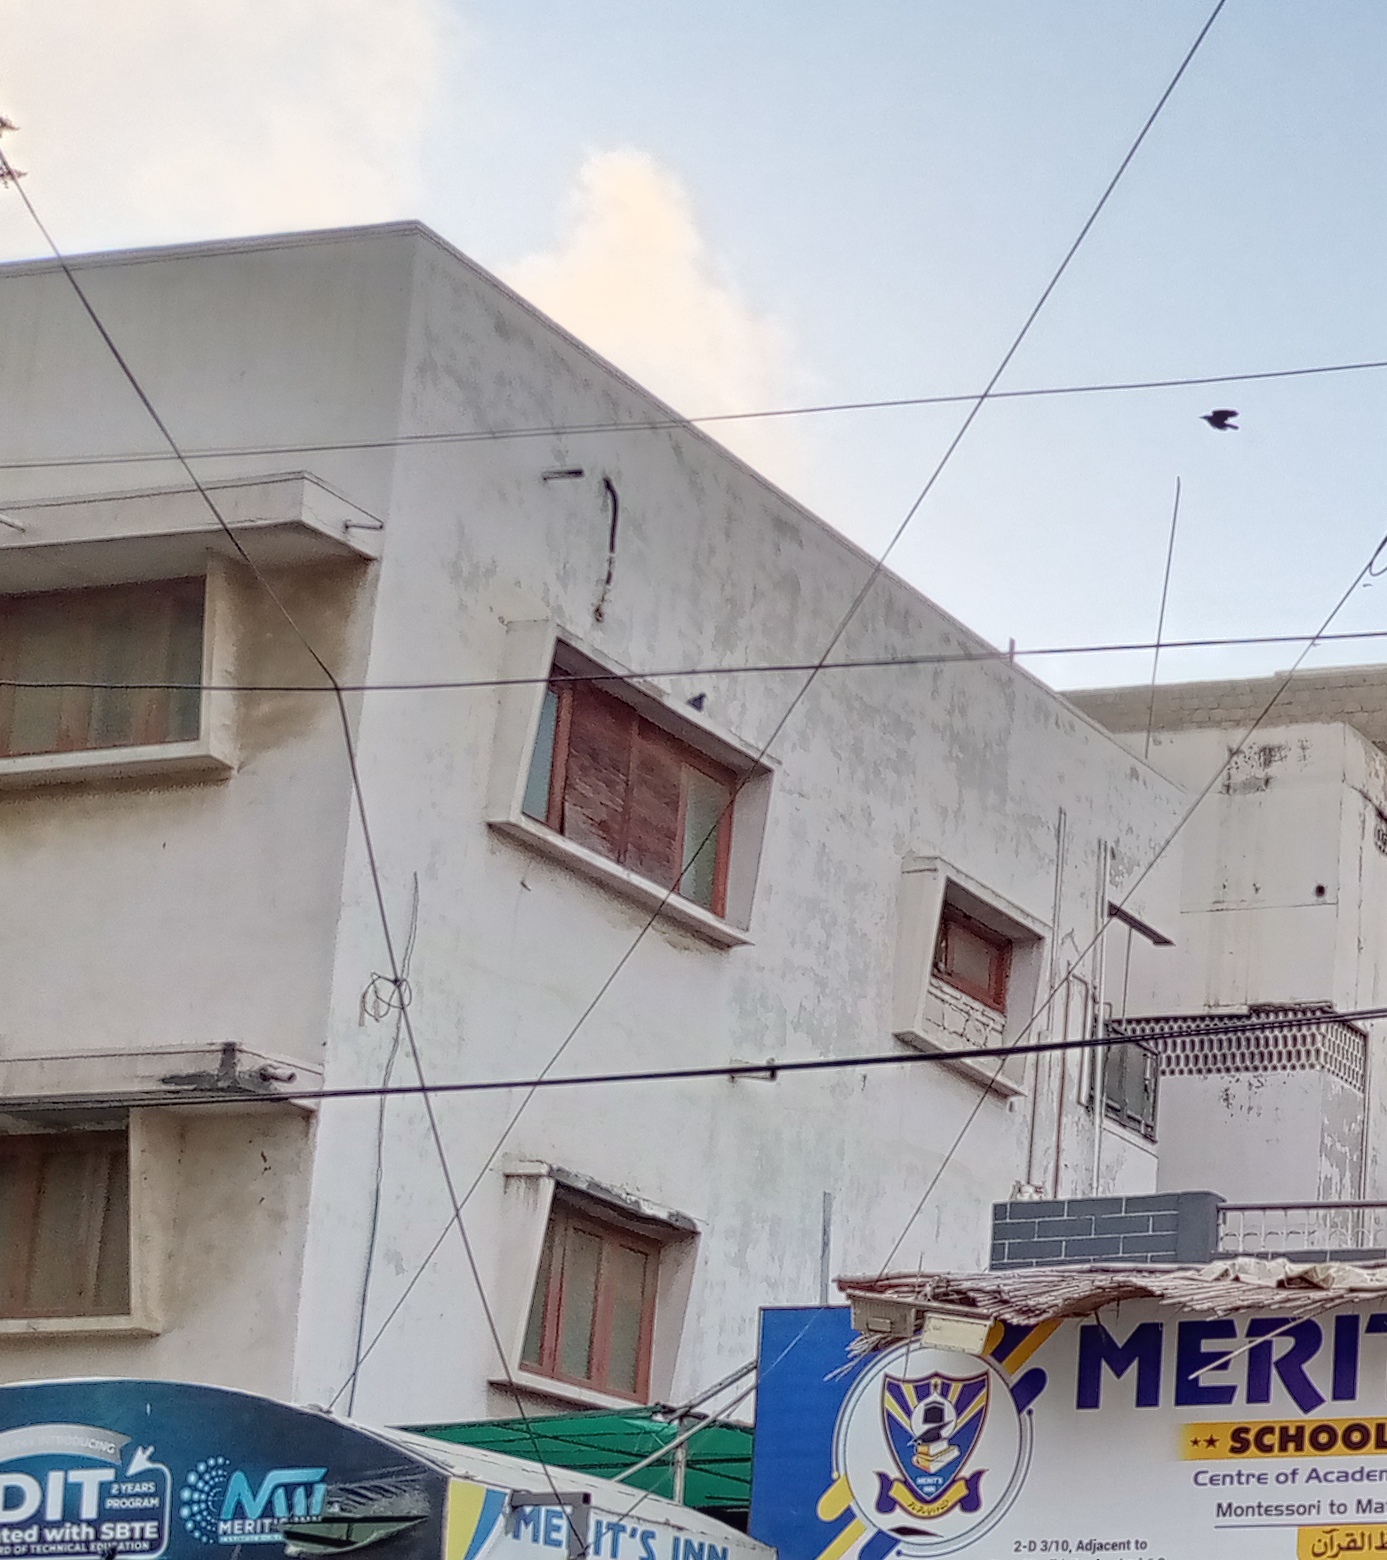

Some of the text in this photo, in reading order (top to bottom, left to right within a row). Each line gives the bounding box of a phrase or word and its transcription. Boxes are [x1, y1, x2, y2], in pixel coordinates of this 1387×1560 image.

[1193, 1468, 1268, 1488] Centre
[1275, 1466, 1299, 1486] of
[120, 1482, 156, 1493] YEARS
[105, 1498, 159, 1509] PROGRAM
[1216, 1499, 1321, 1519] Montessori
[1329, 1500, 1346, 1515] to
[44, 1523, 96, 1542] with
[101, 1522, 159, 1539] SBTE
[14, 1542, 87, 1554] OF TECHNICAL
[1013, 1539, 1148, 1554] 2-D 3/10, Adjacent to
